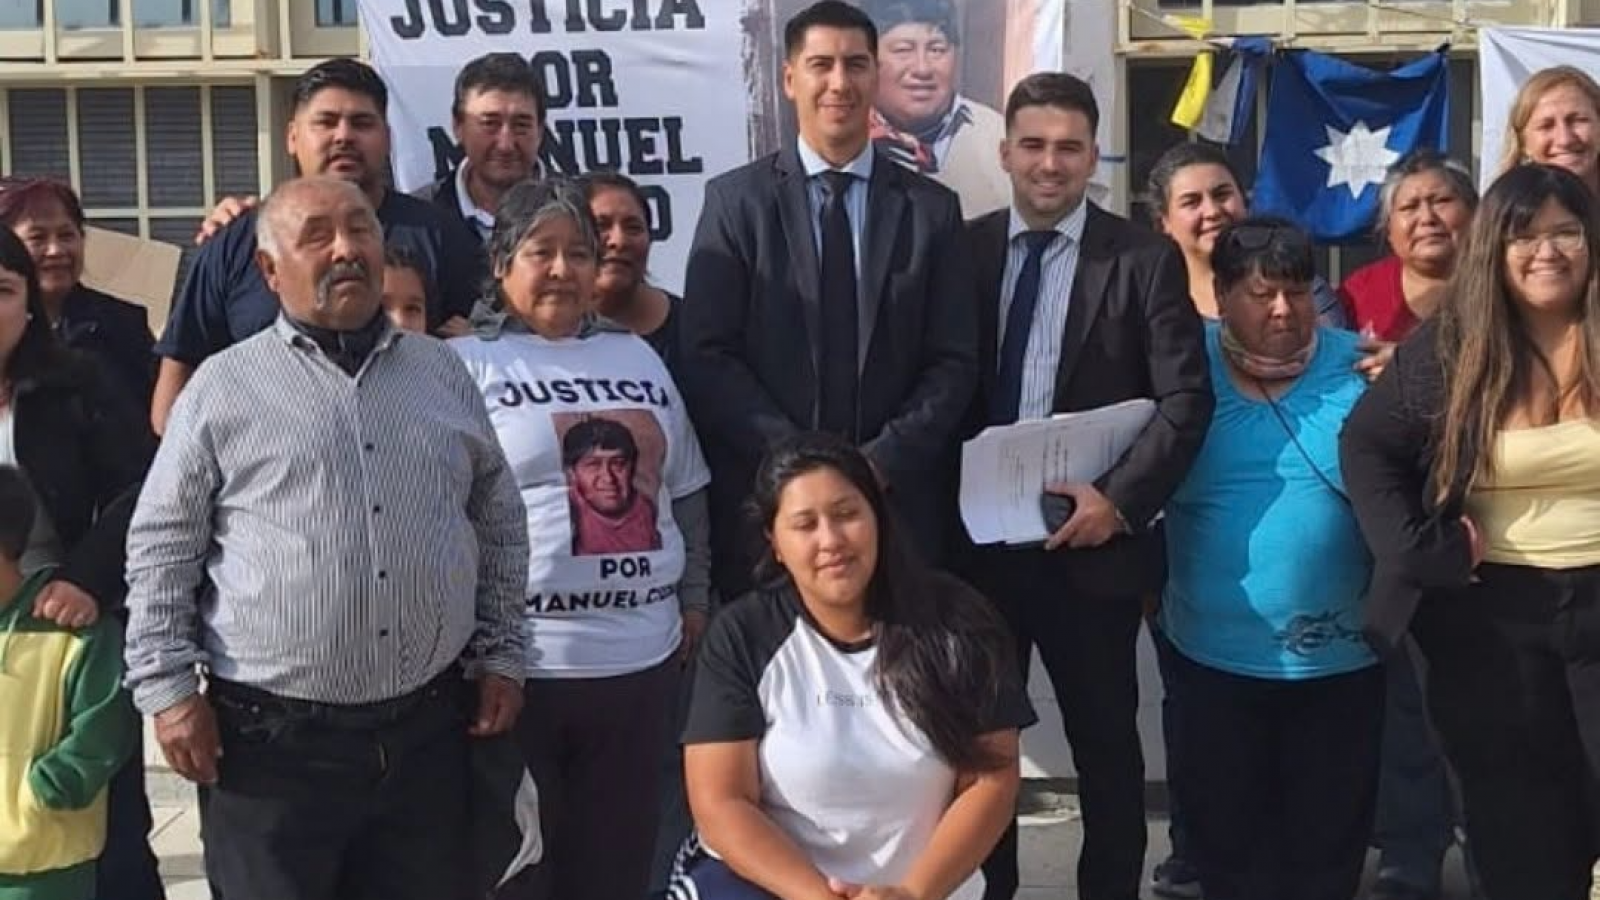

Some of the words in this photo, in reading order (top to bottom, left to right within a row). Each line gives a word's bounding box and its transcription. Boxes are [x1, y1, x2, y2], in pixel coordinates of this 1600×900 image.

[390, 0, 706, 40] JUSTICIA
[529, 49, 619, 109] OR
[427, 116, 703, 181] MNUEL
[601, 556, 652, 580] POR
[525, 589, 639, 613] MANUEL
